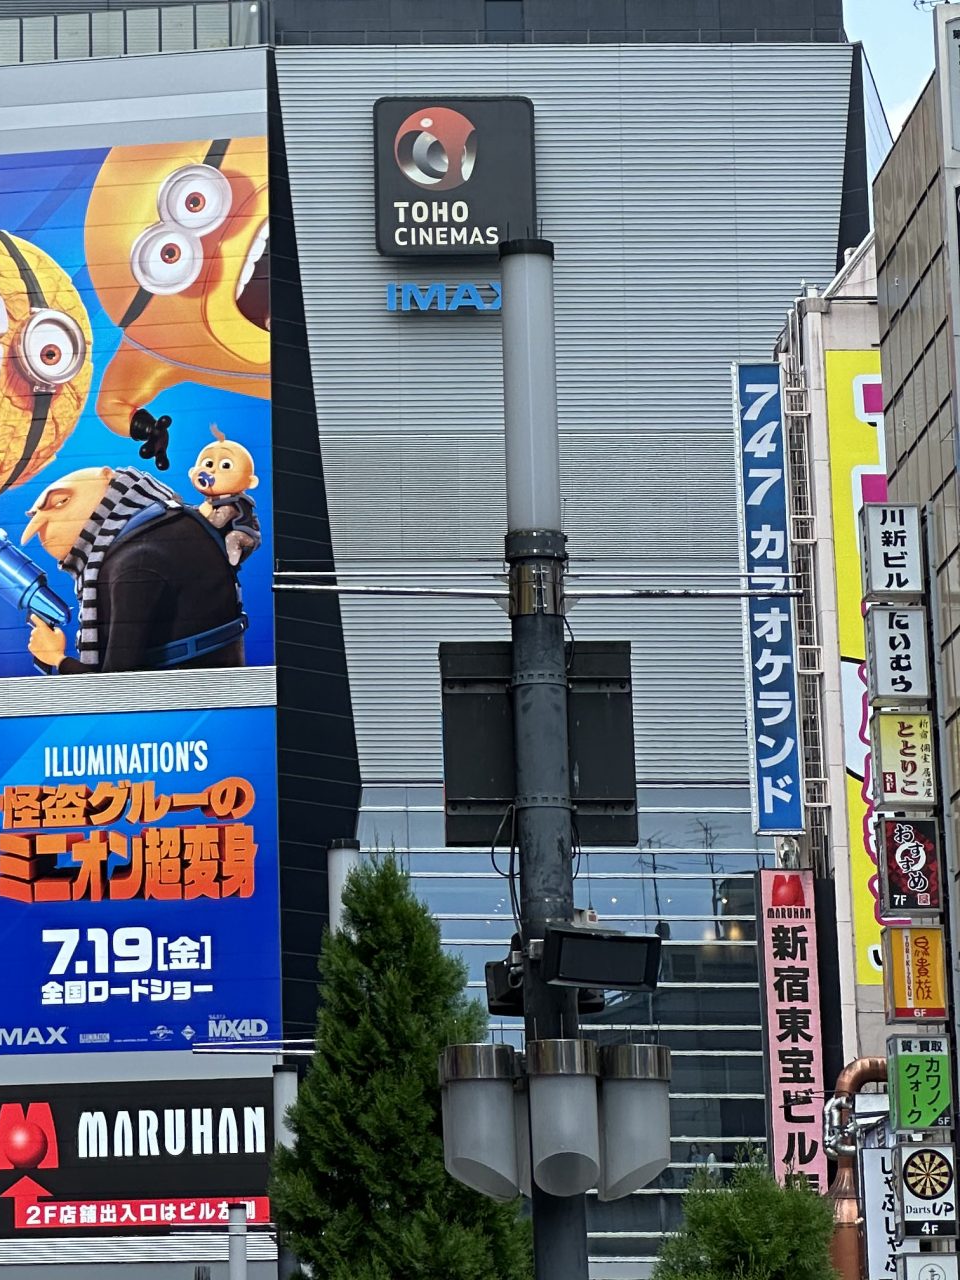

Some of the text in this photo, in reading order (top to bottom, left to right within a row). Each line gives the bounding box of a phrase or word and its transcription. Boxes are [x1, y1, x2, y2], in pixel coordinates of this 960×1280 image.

[394, 201, 469, 223] TOHO
[394, 227, 500, 246] CINEMAS
[880, 508, 908, 588] 川新ビル
[888, 612, 913, 692] にいむら
[44, 740, 209, 777] ILLUMINATION'S
[893, 894, 907, 905] 7F
[767, 907, 812, 920] MARUHAN
[41, 979, 214, 1005] 全国ロードショー
[913, 1008, 927, 1018] 6F
[208, 1018, 269, 1040] MX4D
[78, 1106, 267, 1159] MARUHAN
[905, 1201, 955, 1216] Darts UP
[921, 1221, 939, 1235] 4F
